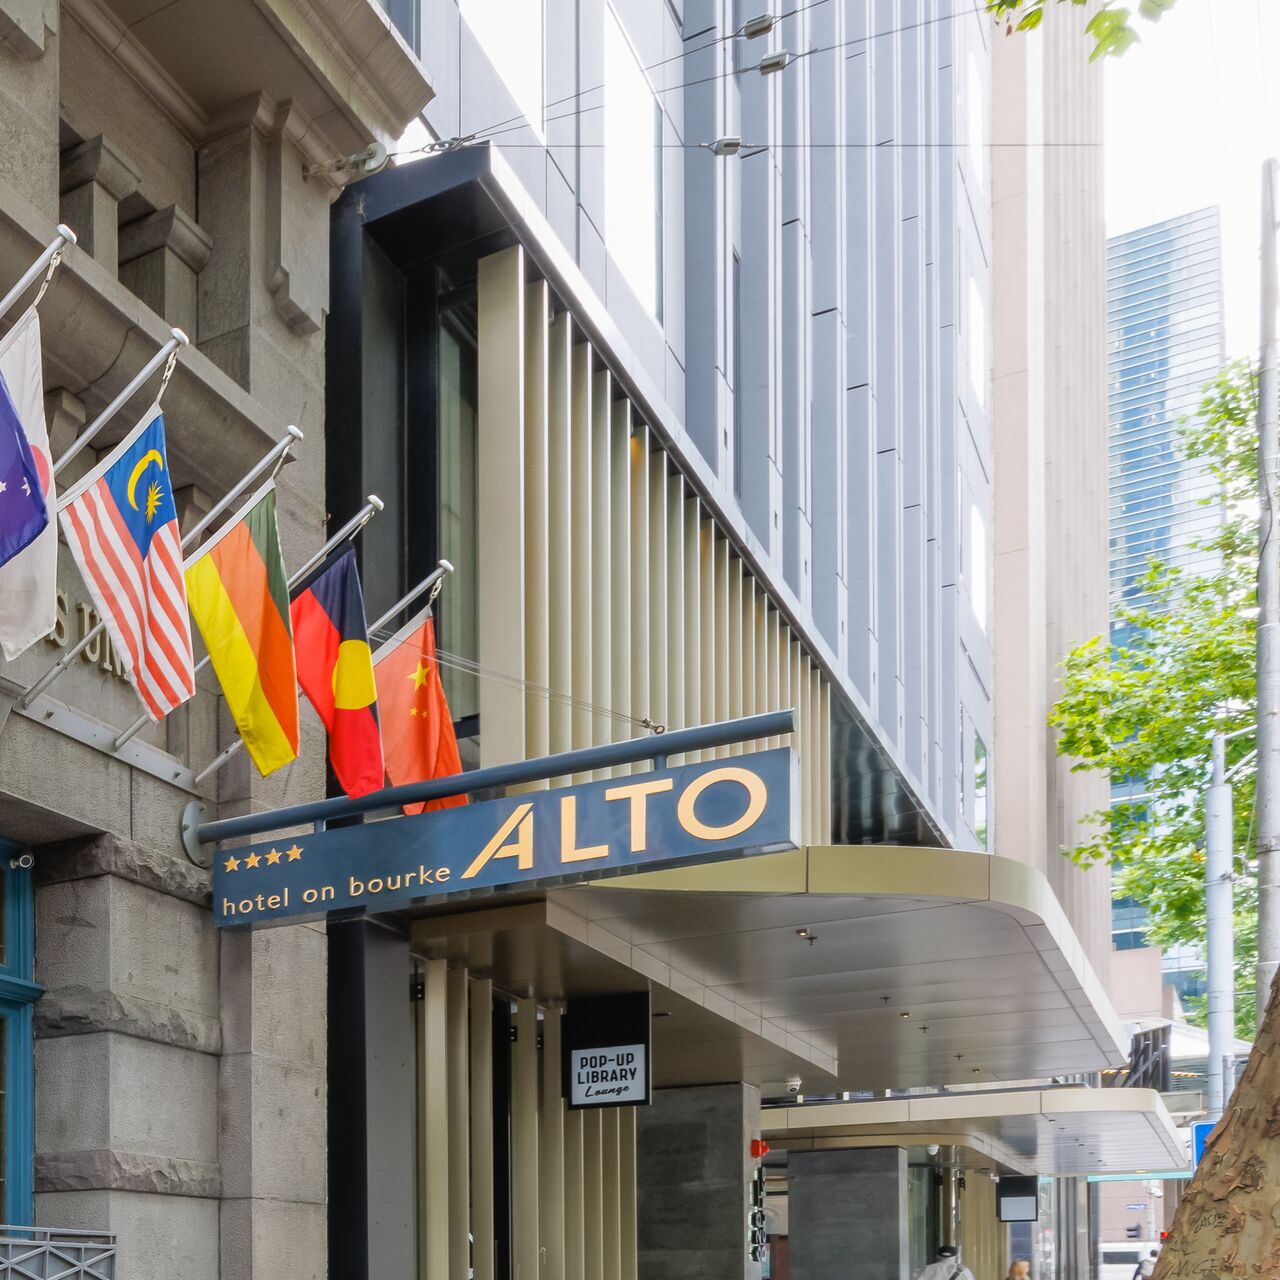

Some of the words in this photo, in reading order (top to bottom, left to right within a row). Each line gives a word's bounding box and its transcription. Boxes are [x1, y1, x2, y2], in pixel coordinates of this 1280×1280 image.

[222, 888, 290, 916] hotel
[302, 884, 335, 905] on
[349, 864, 451, 897] bourke
[461, 766, 768, 879] ALTO
[580, 1052, 635, 1069] POP-UP
[577, 1067, 637, 1084] LIBRARY
[584, 1085, 630, 1098] Lounge
